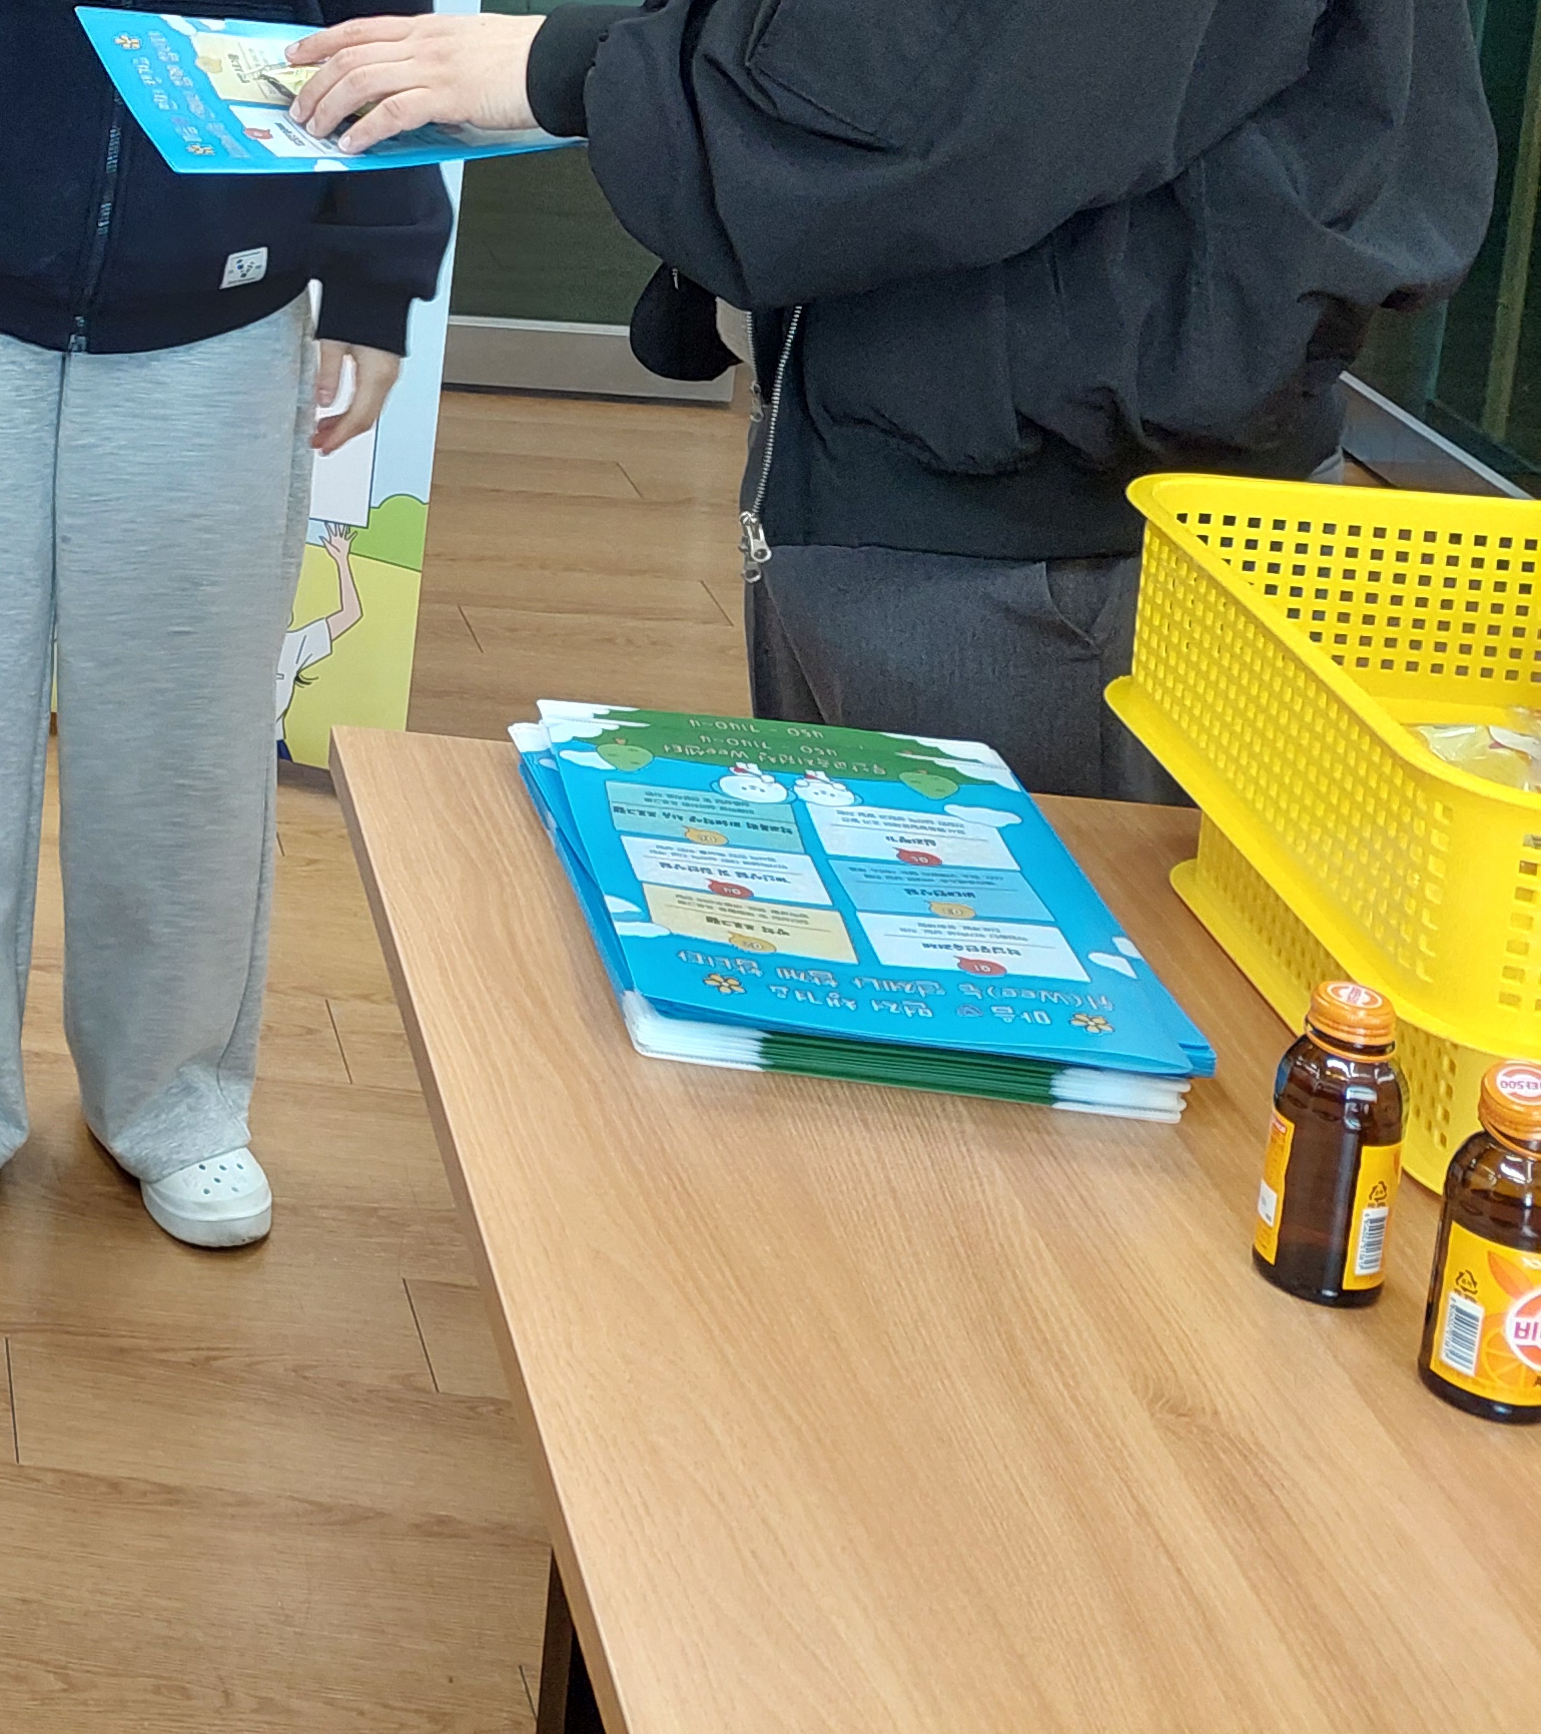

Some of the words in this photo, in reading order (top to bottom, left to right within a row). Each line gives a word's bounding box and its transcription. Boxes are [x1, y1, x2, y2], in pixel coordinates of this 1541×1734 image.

[865, 995, 935, 1018] 먼저
[986, 1004, 1055, 1028] 마음
[1514, 1321, 1541, 1341] 비
